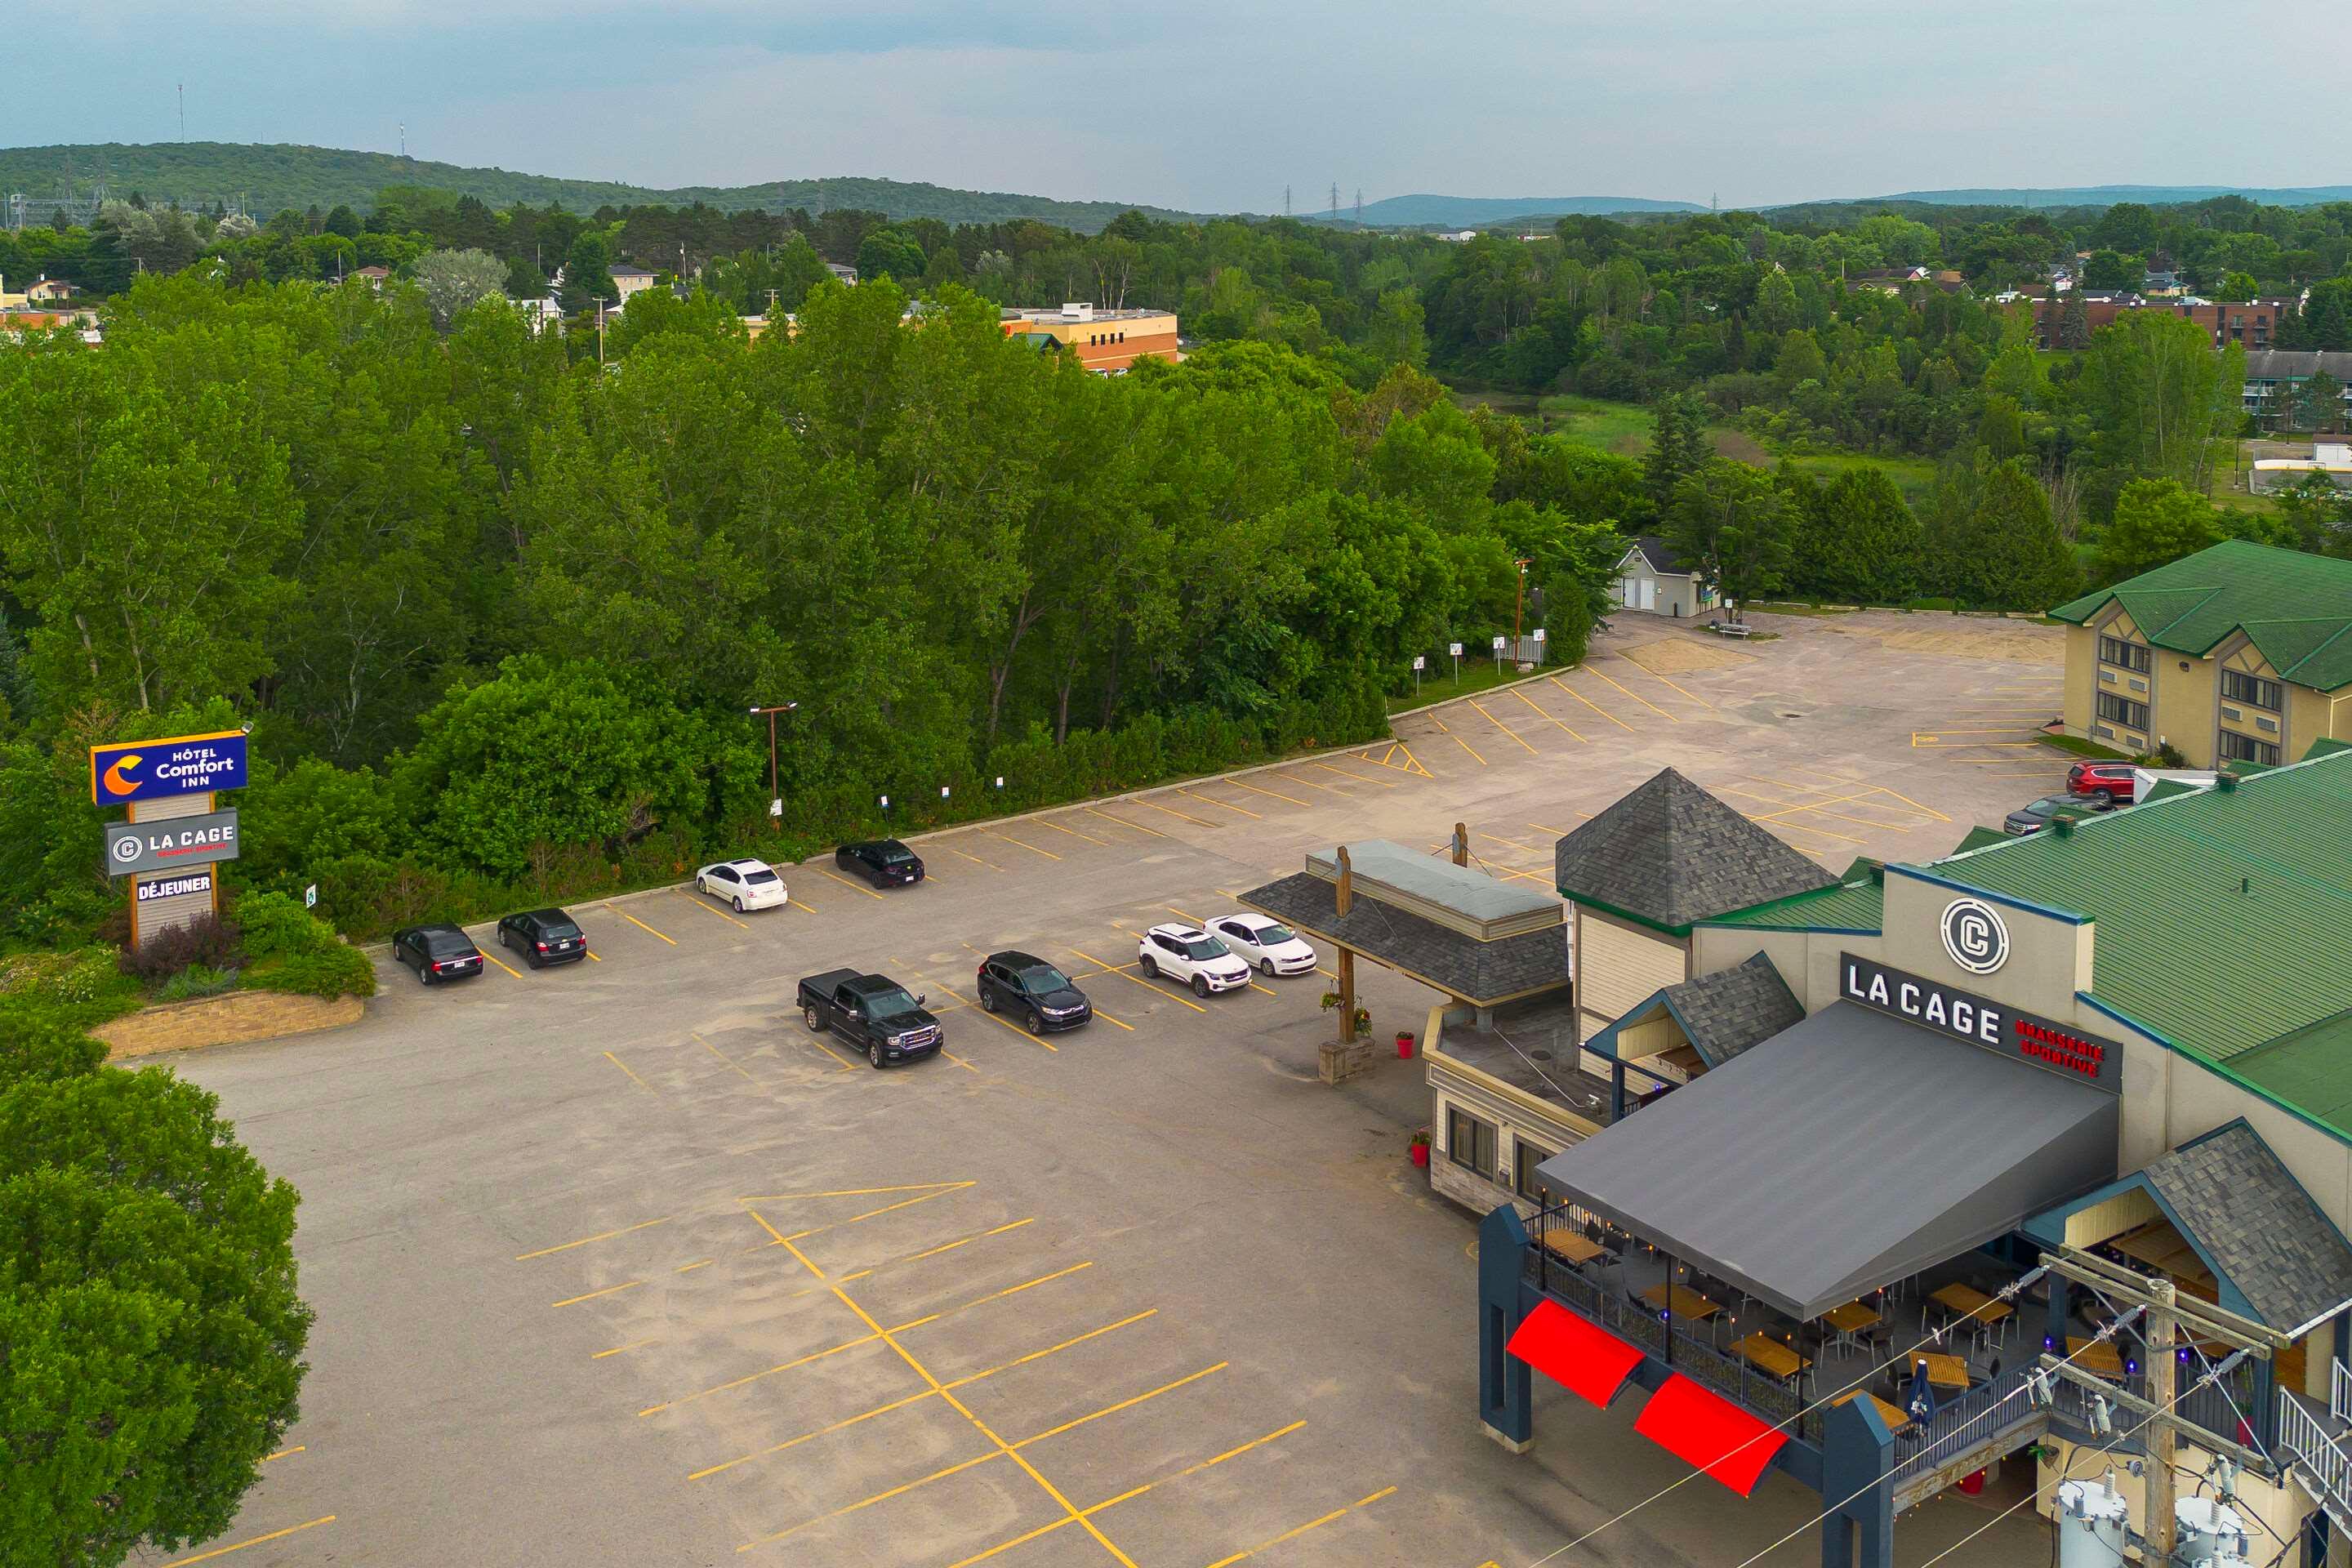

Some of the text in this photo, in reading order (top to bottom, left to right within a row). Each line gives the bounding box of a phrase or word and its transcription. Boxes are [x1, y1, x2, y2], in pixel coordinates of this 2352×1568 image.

[172, 748, 217, 762] HÔTEL
[156, 758, 234, 778] Comfort
[182, 776, 209, 788] INN
[149, 835, 174, 850] LA
[180, 826, 234, 846] CAGE
[138, 876, 210, 900] DÉJEUNER
[1849, 964, 2000, 1045] LA CAGE
[2015, 1019, 2104, 1062] BRASSERIE
[2020, 1039, 2099, 1079] SPORTIVE
